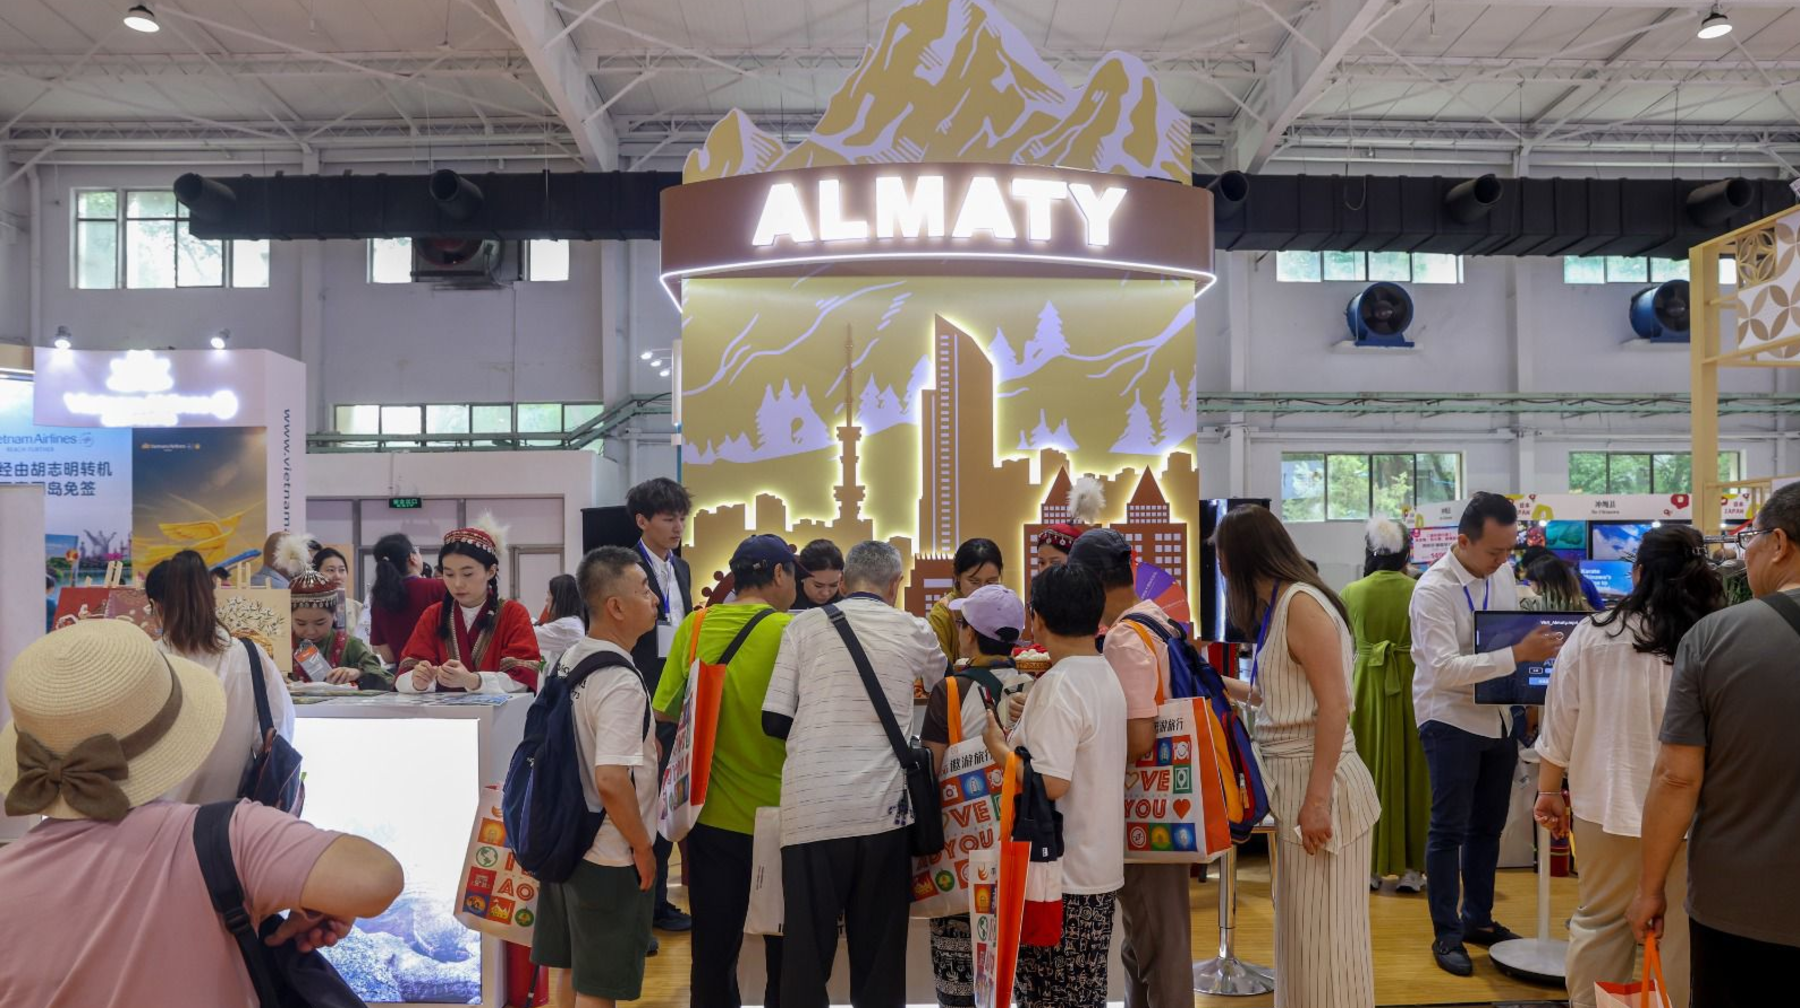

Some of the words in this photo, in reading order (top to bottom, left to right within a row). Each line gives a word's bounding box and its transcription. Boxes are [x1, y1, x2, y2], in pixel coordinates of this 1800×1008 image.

[752, 175, 1127, 246] ALMATY
[0, 461, 112, 477] 经由胡志明转机
[283, 408, 292, 532] www.vietnam
